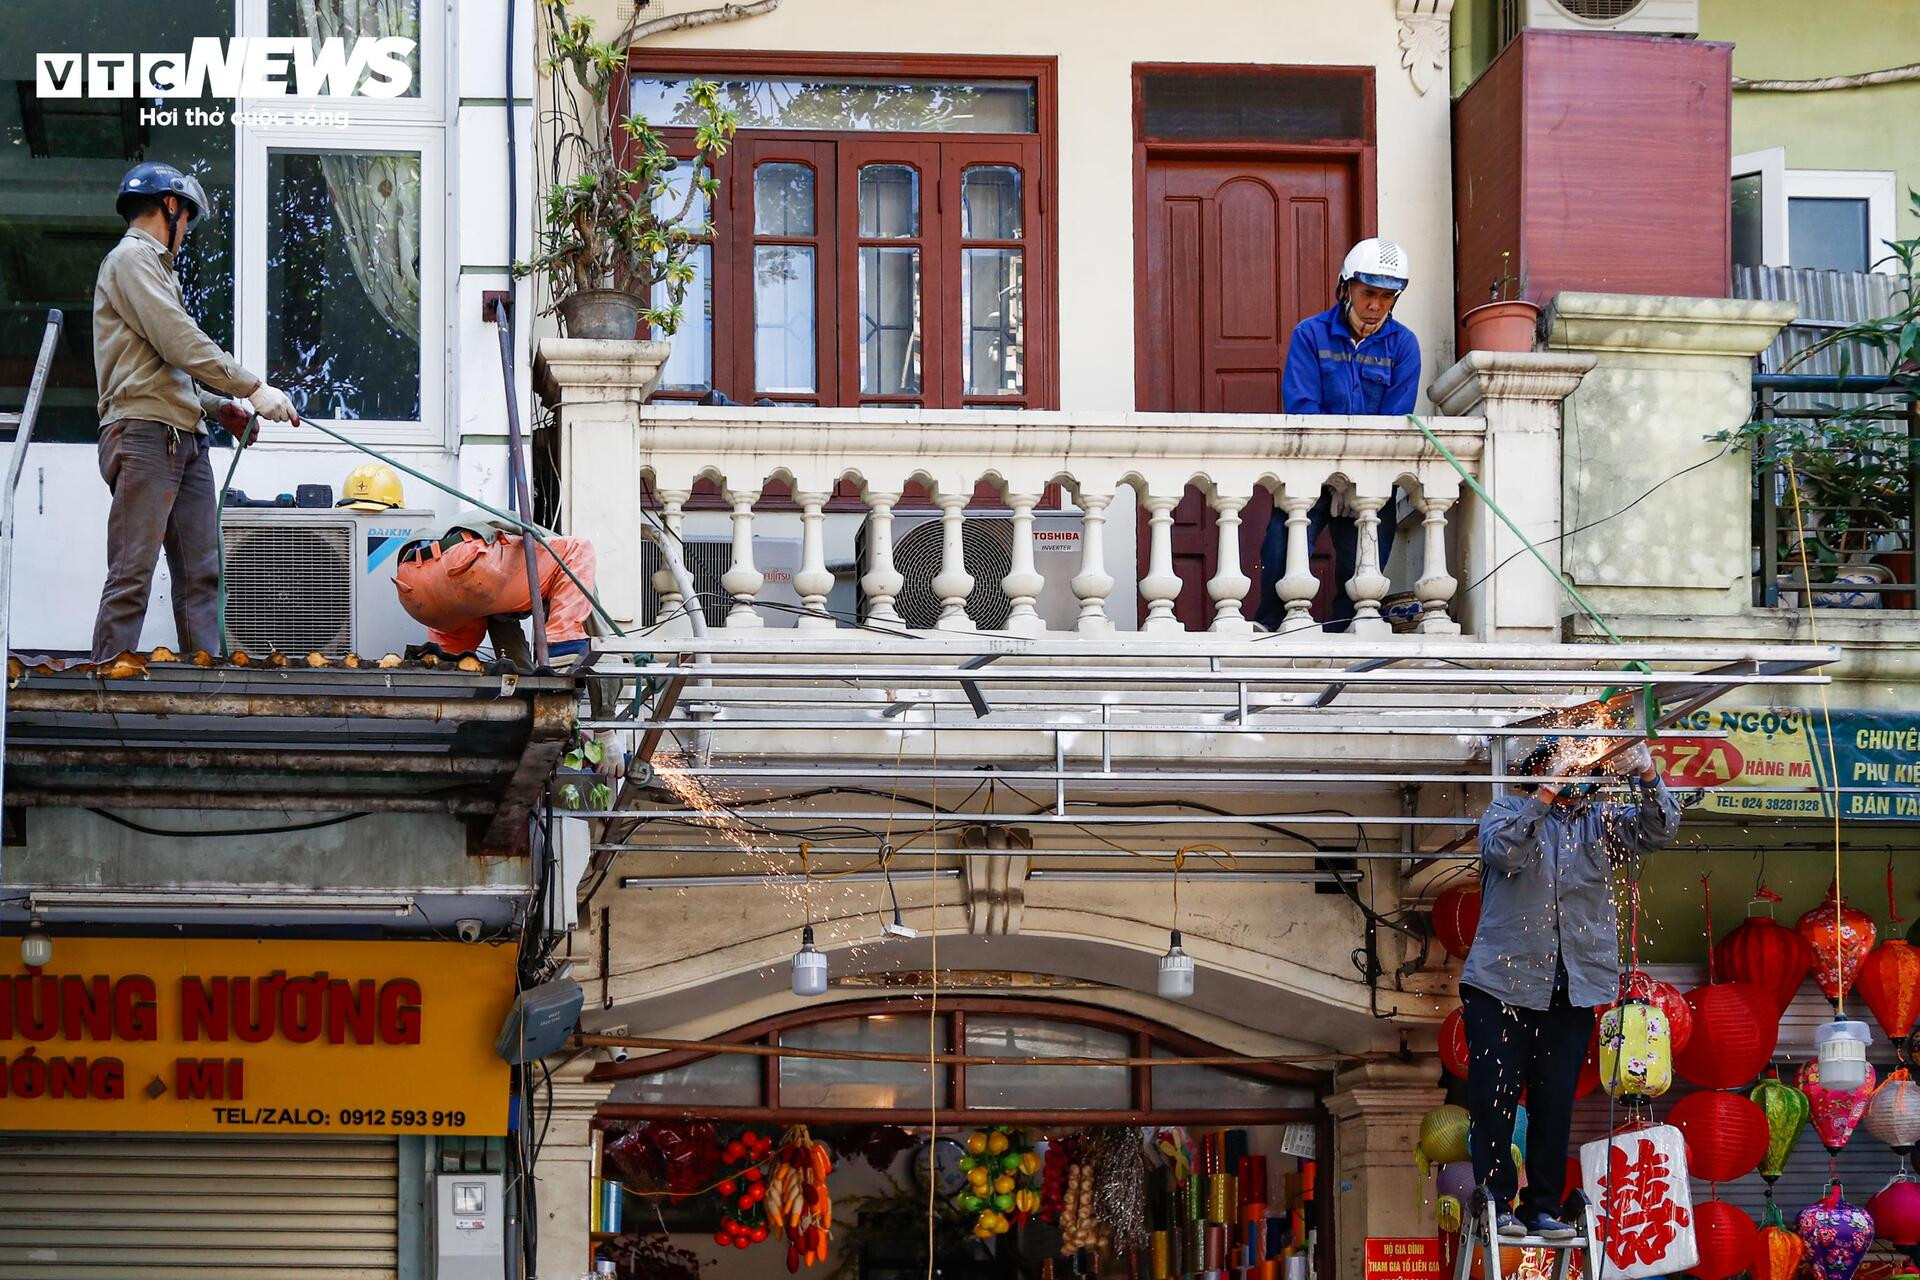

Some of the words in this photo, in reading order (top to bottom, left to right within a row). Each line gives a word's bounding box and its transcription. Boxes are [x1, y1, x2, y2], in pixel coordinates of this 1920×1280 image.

[368, 528, 412, 536] DAIKIN
[1033, 532, 1080, 541] TOSHIBA
[763, 571, 792, 583] FUJITSU
[1720, 710, 1800, 740] NGỌC
[1856, 727, 1920, 752] CHUYÊ
[1745, 758, 1785, 778] HÀNG
[1788, 760, 1812, 778] MÃ
[1853, 762, 1890, 786] PHỤ
[1716, 796, 1739, 809] TEL:
[1742, 797, 1763, 810] 024
[1765, 798, 1819, 812] 38281328
[1851, 792, 1890, 815] BÁN
[1896, 793, 1920, 816] VÀ
[0, 963, 158, 1042] ÙNG
[181, 970, 423, 1046] NƯƠNG
[0, 1046, 125, 1100] ÓNG
[176, 1058, 244, 1101] MI
[212, 1107, 330, 1126] TEL/ZALO:
[340, 1109, 386, 1126] 0912
[391, 1110, 428, 1126] 593
[432, 1111, 467, 1127] 919
[1395, 1244, 1407, 1255] GIA
[1369, 1261, 1388, 1272] THAM
[1389, 1261, 1401, 1272] GIA
[1428, 1261, 1440, 1272] GIA
